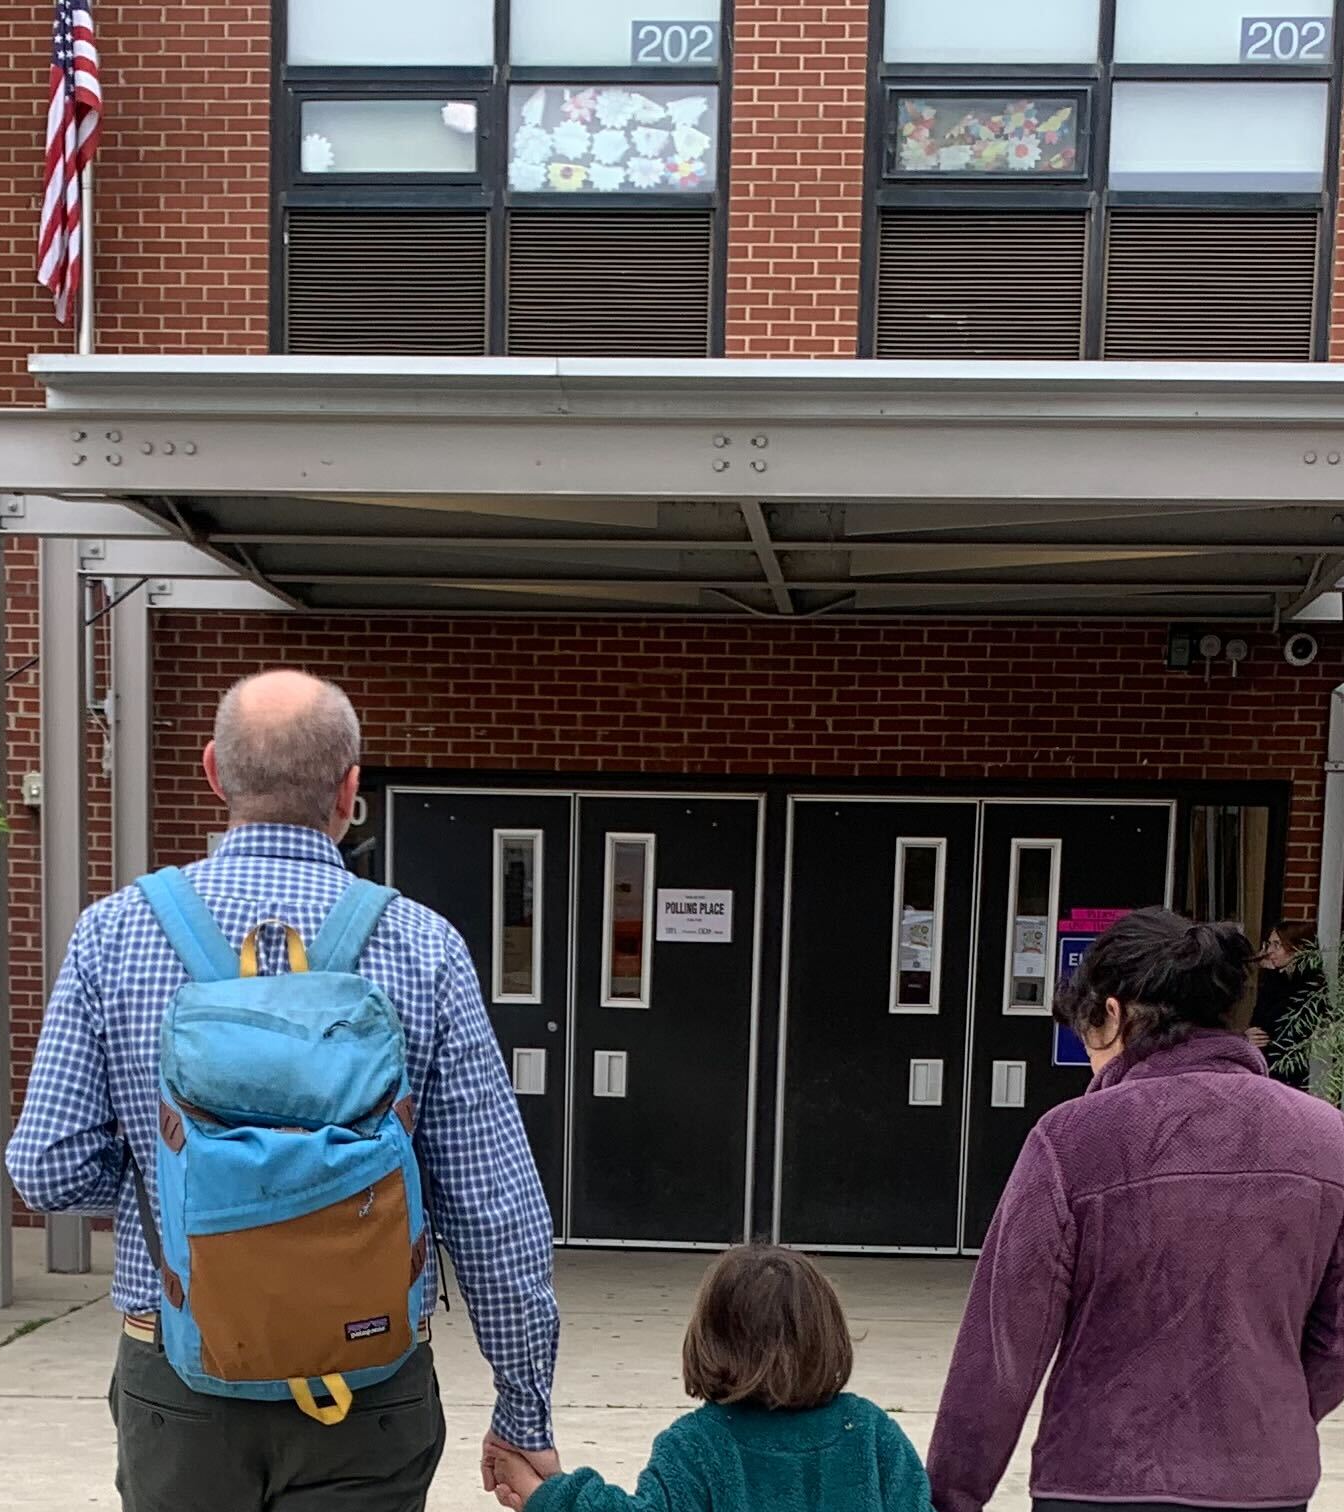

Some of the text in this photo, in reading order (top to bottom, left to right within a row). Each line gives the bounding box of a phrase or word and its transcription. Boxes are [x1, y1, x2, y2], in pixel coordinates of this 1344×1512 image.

[636, 25, 714, 64] 202
[1246, 21, 1327, 60] 202
[665, 902, 725, 915] POLLING PLACE
